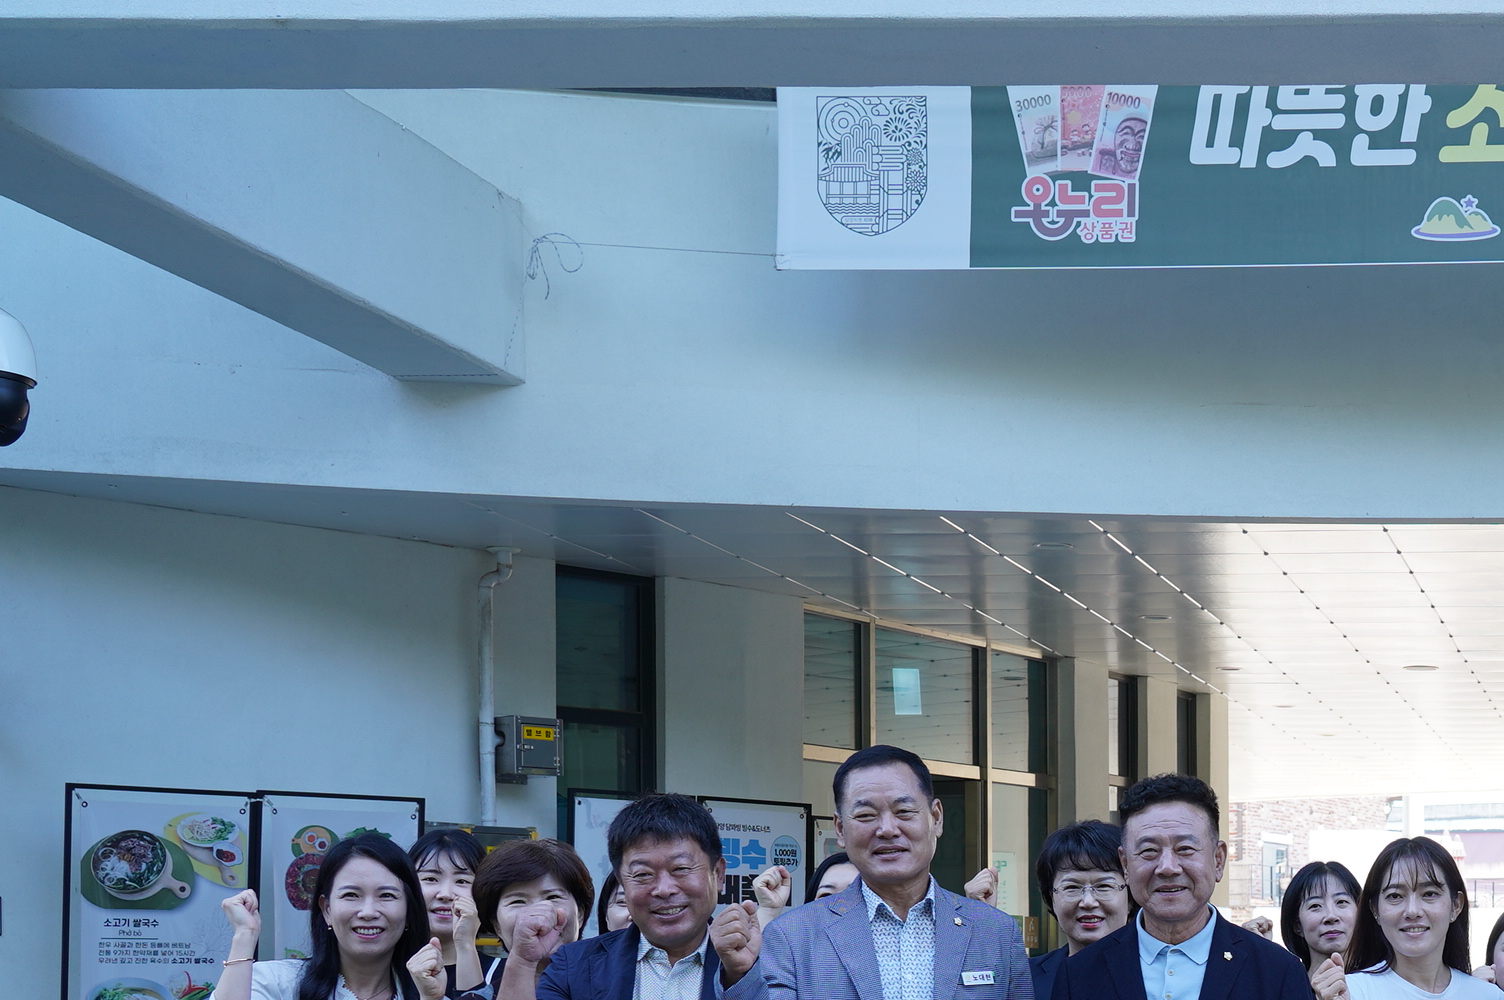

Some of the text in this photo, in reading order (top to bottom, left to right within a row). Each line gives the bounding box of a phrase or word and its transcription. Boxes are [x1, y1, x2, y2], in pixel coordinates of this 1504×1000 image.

[1015, 94, 1051, 112] 30000
[1106, 92, 1141, 109] 10000
[1189, 85, 1433, 168] 따뜻한
[1080, 221, 1133, 241] 상품권
[103, 918, 159, 928] 소고기 쌀국수
